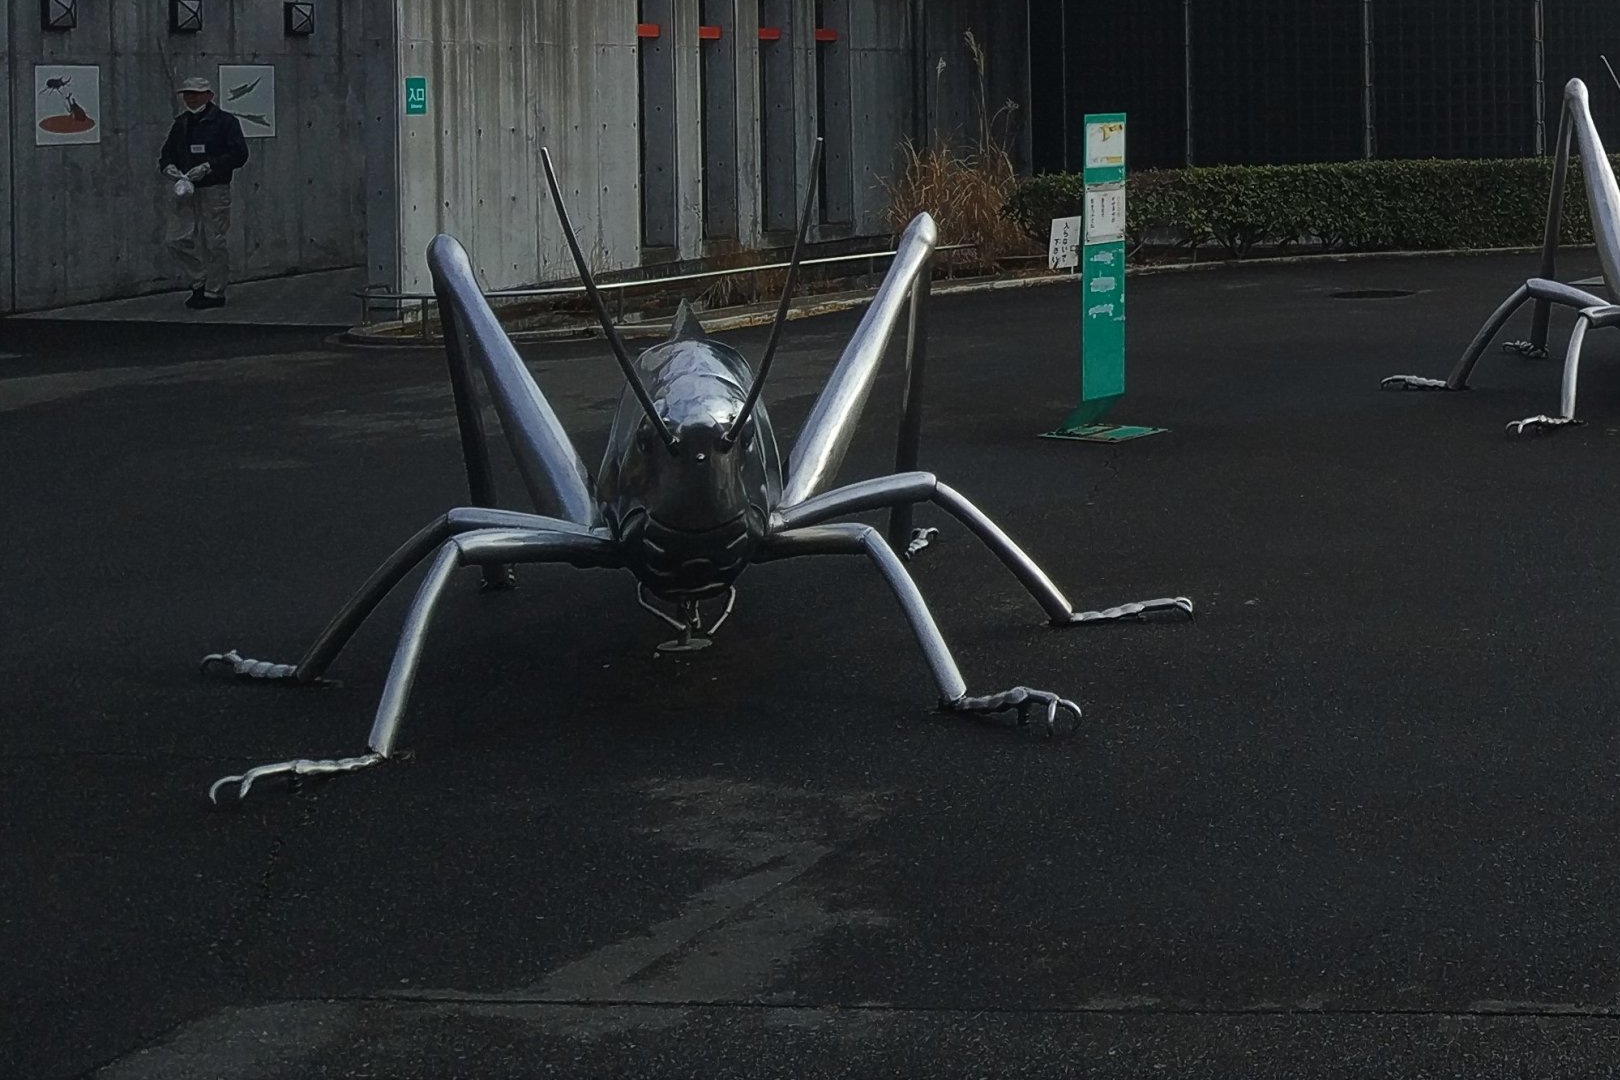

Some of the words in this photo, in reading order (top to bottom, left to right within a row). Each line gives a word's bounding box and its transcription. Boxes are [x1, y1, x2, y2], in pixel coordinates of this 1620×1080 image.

[408, 88, 424, 101] 入口
[1061, 221, 1071, 262] 入らないで
